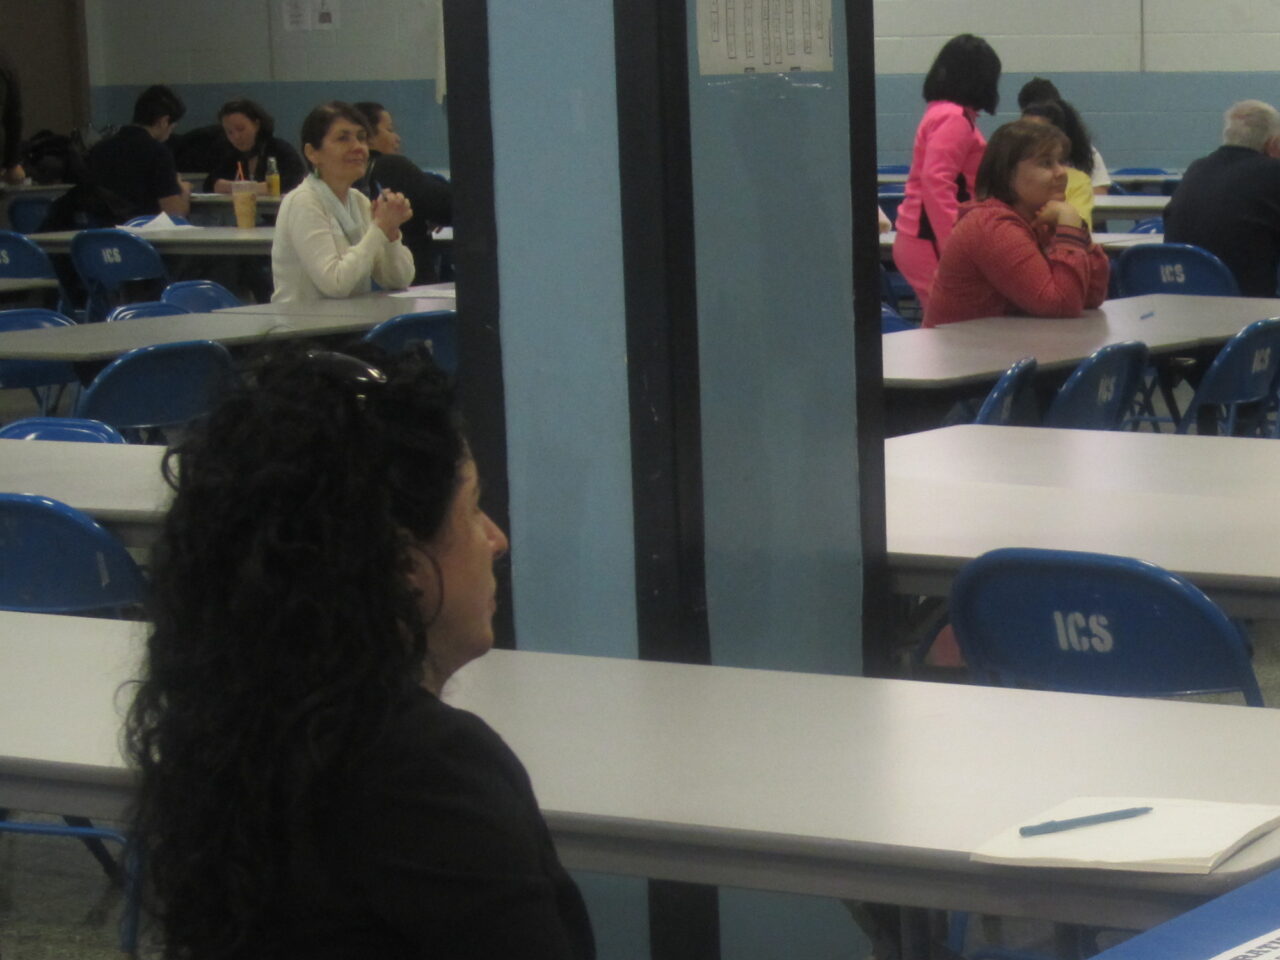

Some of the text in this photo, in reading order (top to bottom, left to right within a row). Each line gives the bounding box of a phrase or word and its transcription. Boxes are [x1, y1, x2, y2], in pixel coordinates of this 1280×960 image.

[102, 248, 121, 263] ICS
[1160, 264, 1185, 283] ICS
[1053, 611, 1113, 653] ICS
